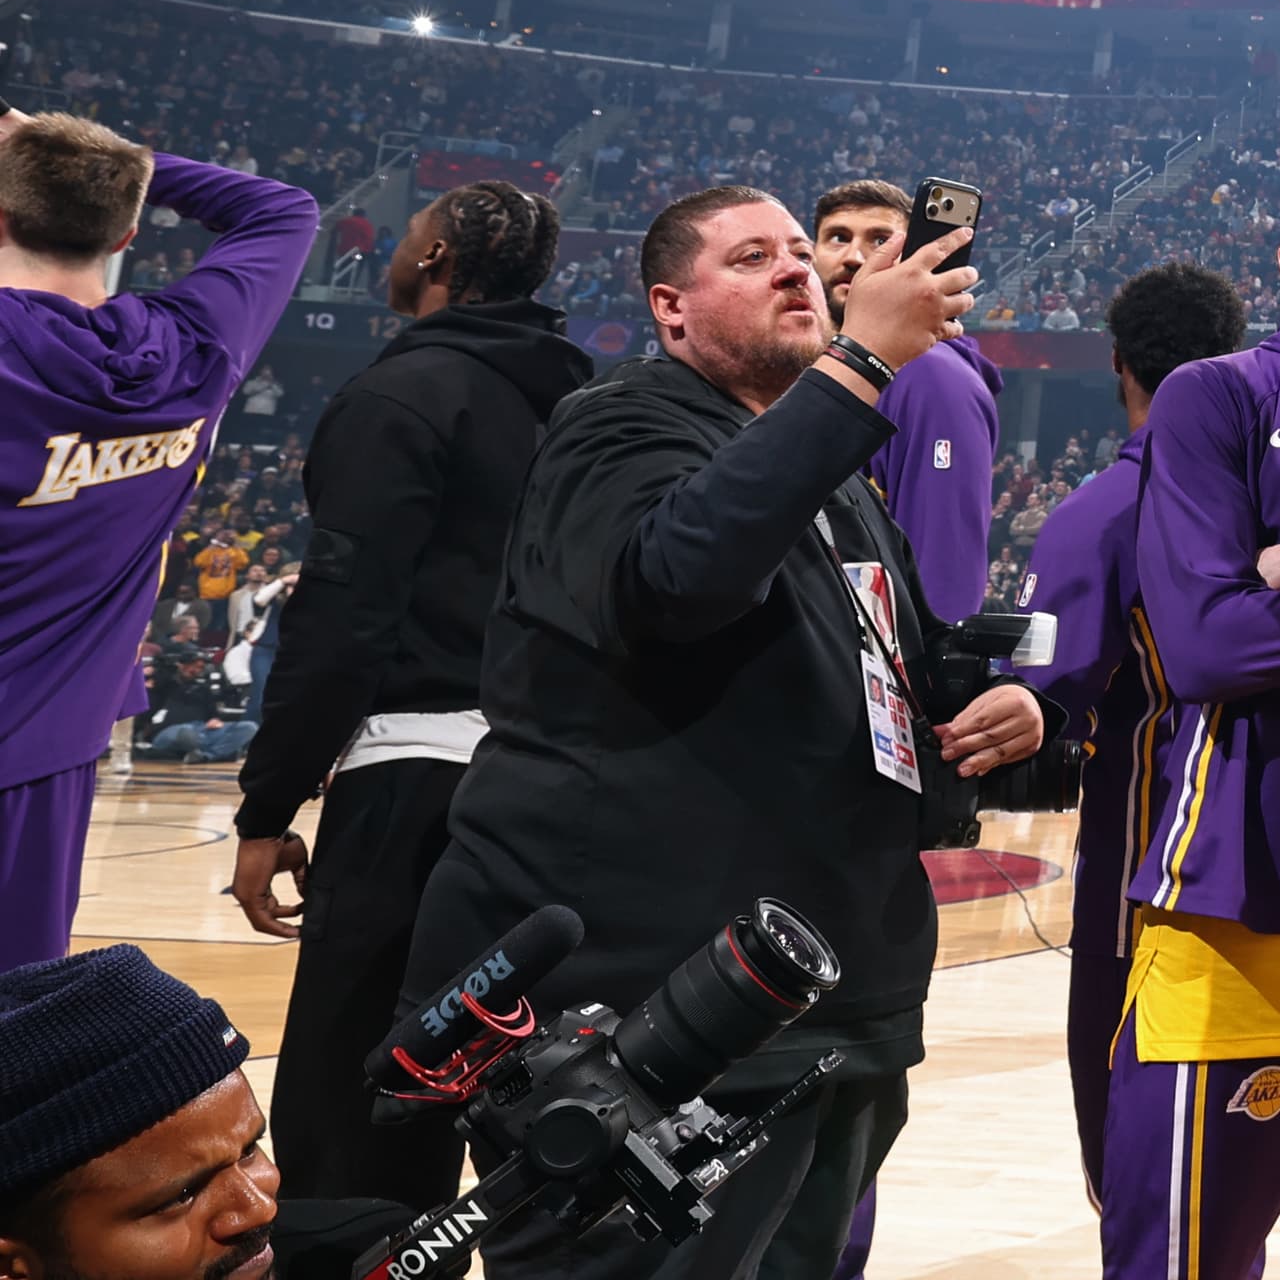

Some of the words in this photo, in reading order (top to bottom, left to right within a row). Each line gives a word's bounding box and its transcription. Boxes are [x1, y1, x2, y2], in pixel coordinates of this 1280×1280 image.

[305, 312, 335, 330] 1Q
[17, 417, 208, 508] LAKERS
[386, 1199, 489, 1280] RONIN
